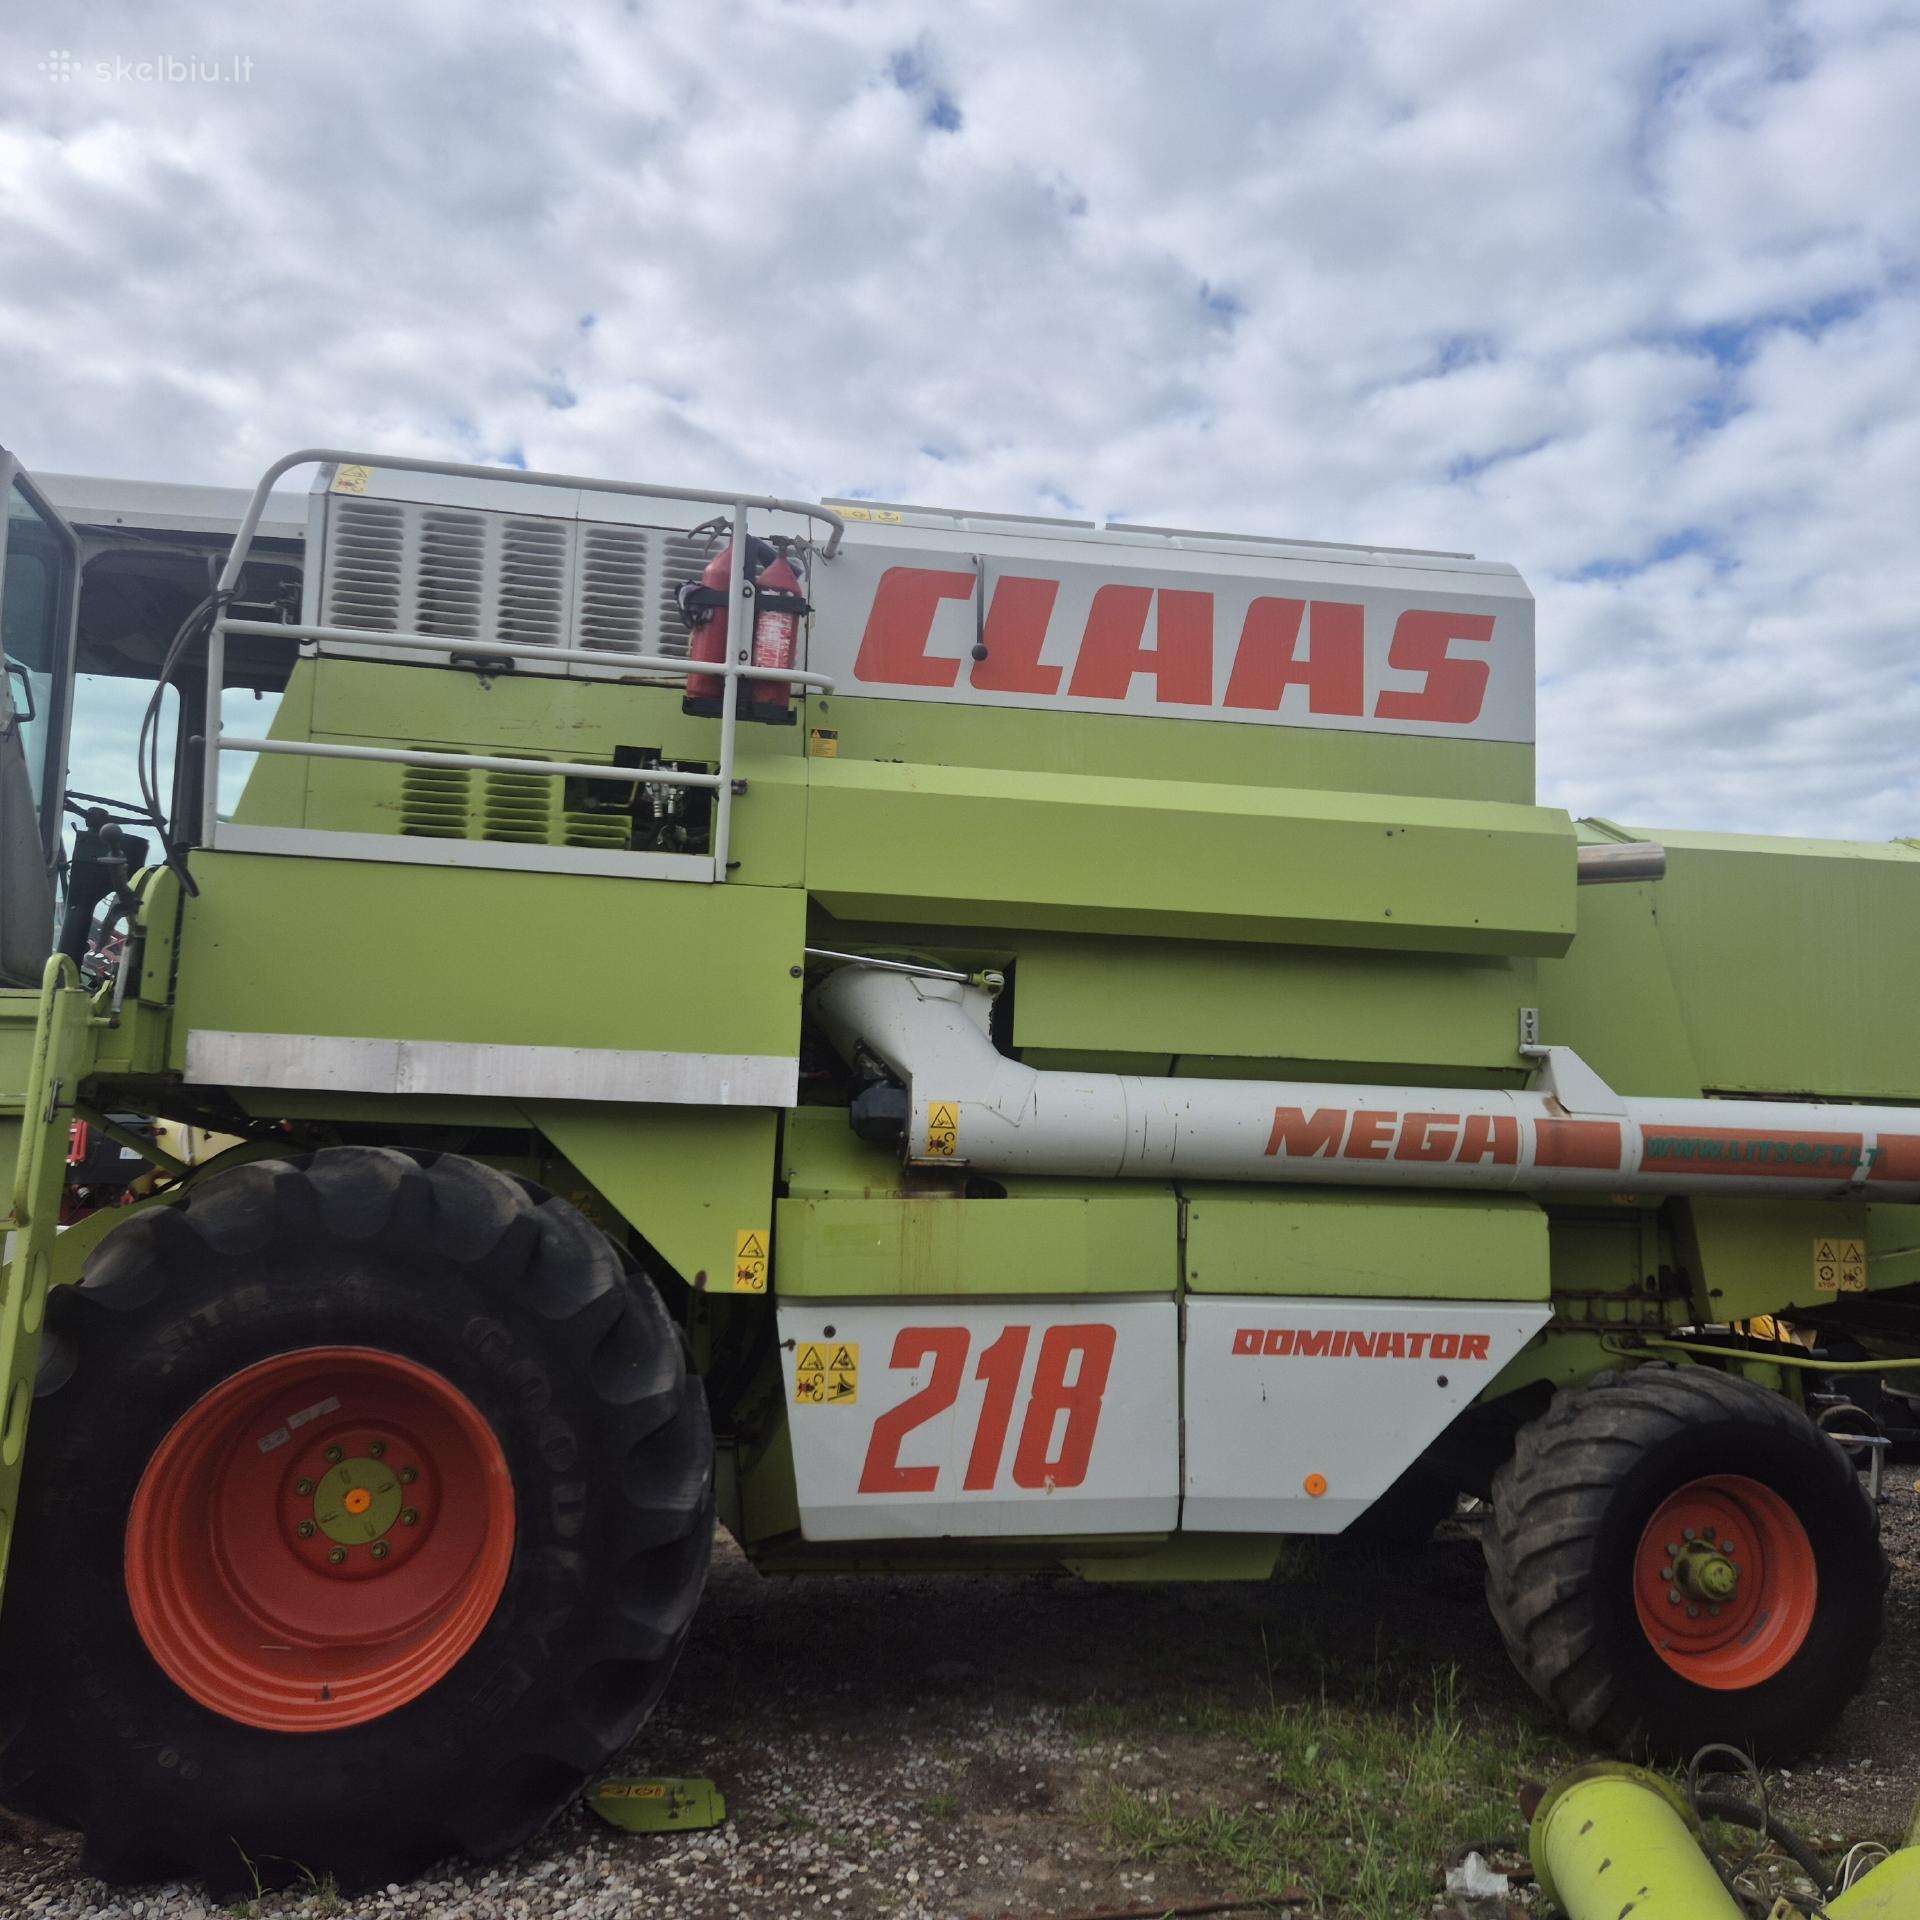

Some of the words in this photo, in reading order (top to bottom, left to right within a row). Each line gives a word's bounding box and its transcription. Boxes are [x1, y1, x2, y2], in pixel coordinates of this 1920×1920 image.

[853, 566, 1496, 724] CLAAS
[1264, 1106, 1518, 1165] MEGA
[1232, 1328, 1491, 1361] DOMINATOR
[858, 1323, 1117, 1494] 218
